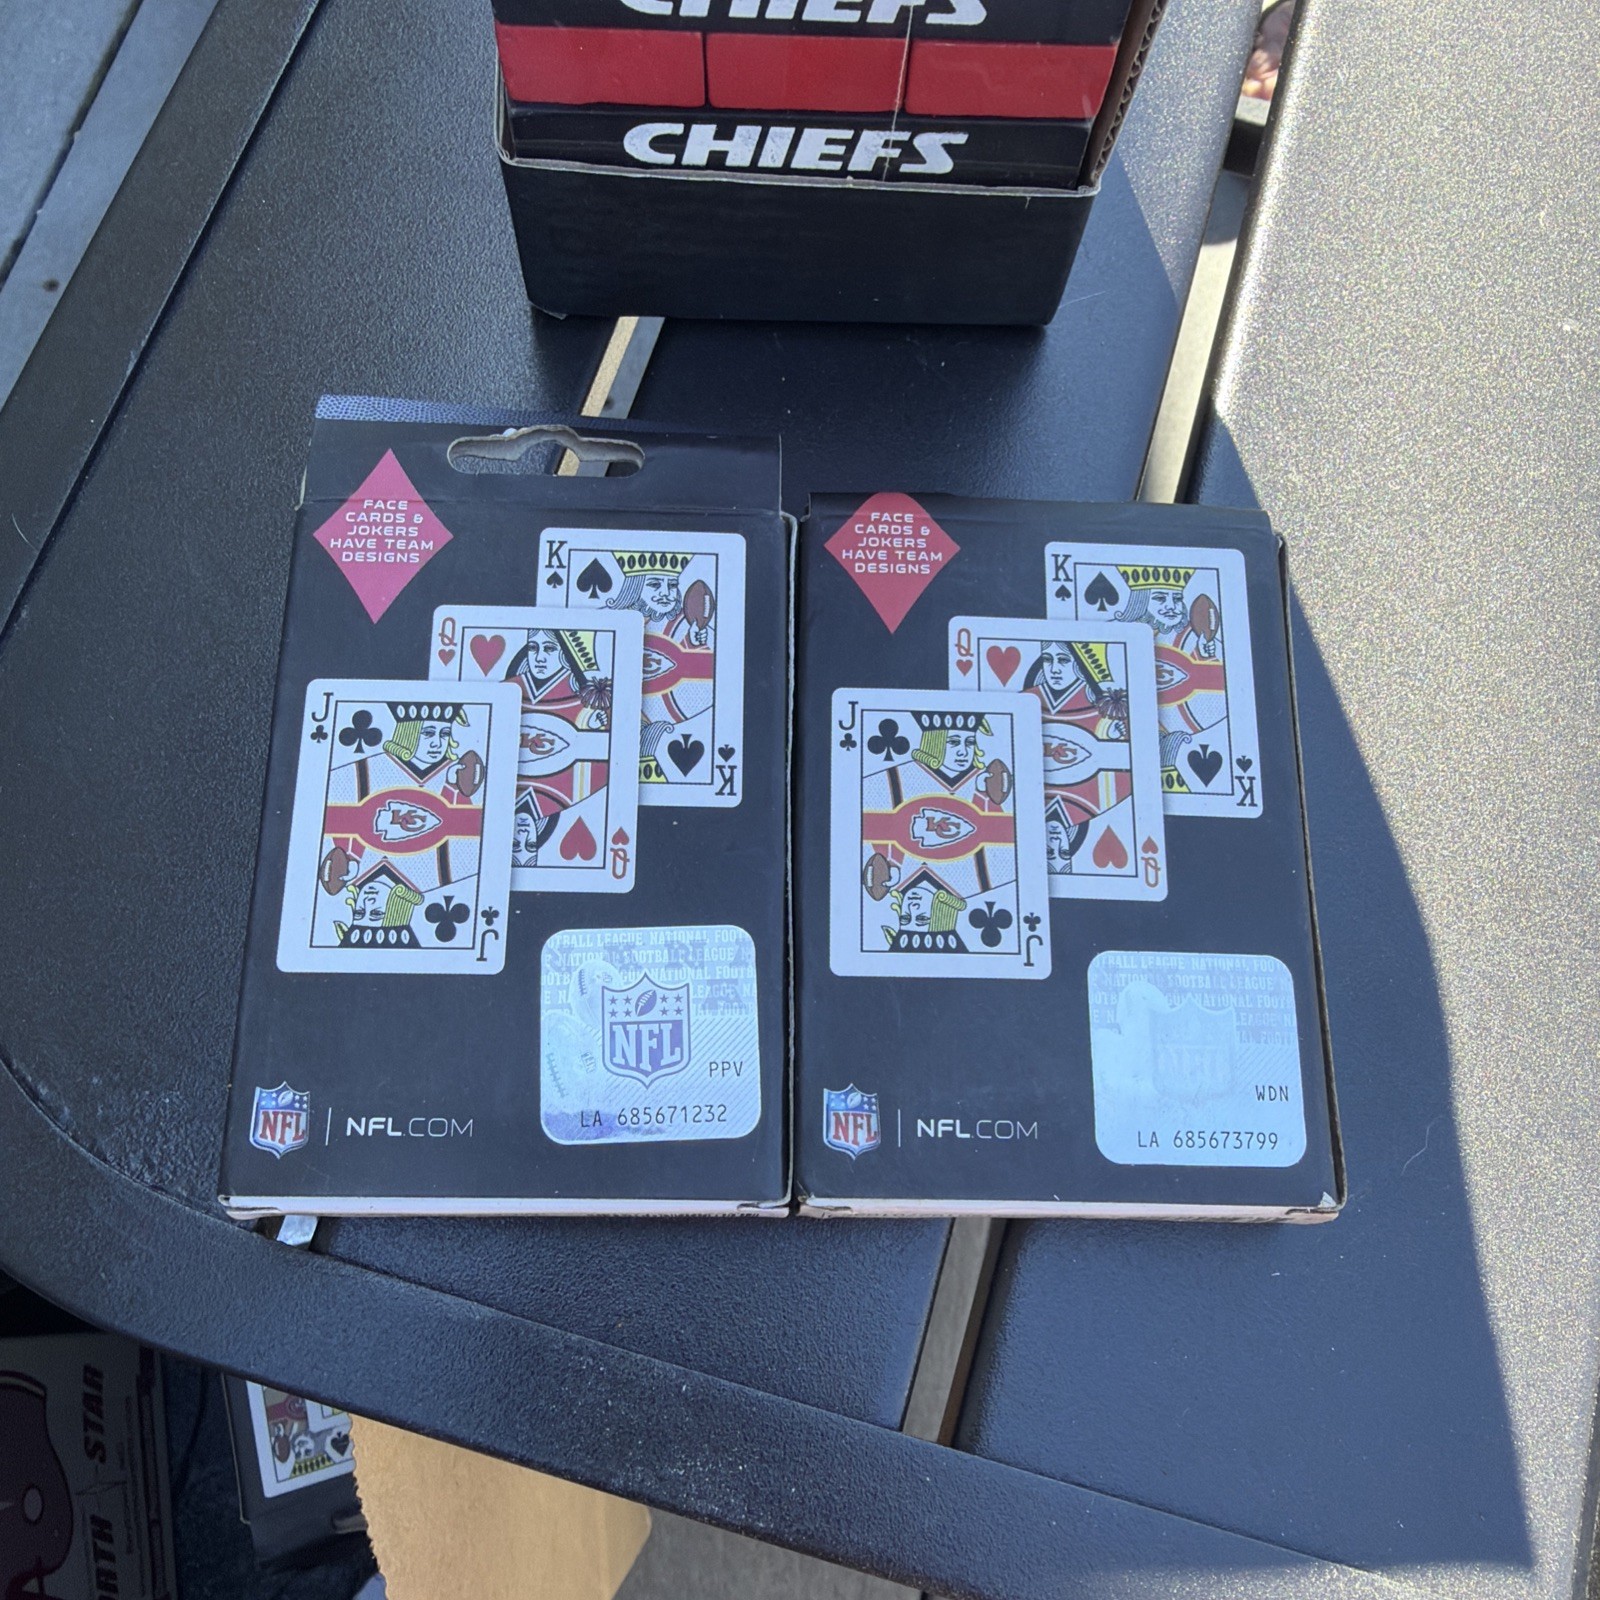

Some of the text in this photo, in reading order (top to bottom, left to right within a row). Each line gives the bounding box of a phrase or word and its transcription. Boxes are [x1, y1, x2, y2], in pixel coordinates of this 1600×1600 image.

[622, 122, 970, 175] CHIEFS
[345, 511, 424, 524] CARDS &
[363, 499, 409, 511] FACE
[870, 512, 914, 523] FACE
[329, 538, 434, 551] HAVE TEAM
[346, 525, 419, 537] JOKERS
[854, 523, 931, 536] CARDS &
[857, 537, 927, 549] JOKERS
[341, 551, 421, 564] DESIGNS
[545, 540, 568, 570] K
[841, 549, 943, 562] HAVE TEAM
[854, 562, 931, 575] DESIGNS
[1051, 553, 1073, 583] K
[438, 616, 458, 647] Q
[954, 627, 974, 658] Q
[311, 691, 334, 722] J
[838, 700, 860, 731] J
[715, 764, 738, 797] K
[1235, 775, 1258, 807] K
[610, 847, 629, 880] Q
[1142, 856, 1162, 888] Q
[476, 929, 499, 962] J
[649, 928, 710, 945] NATIONAL
[1023, 934, 1044, 967] J
[612, 1022, 682, 1073] NFL
[708, 1061, 744, 1078] PPV
[1255, 1084, 1290, 1102] WDN
[259, 1110, 306, 1146] NFL
[346, 1117, 474, 1138] NFL.COM
[579, 1104, 728, 1128] LA 685671232
[831, 1111, 878, 1147] NFL
[916, 1118, 1039, 1140] NFL.COM
[1136, 1130, 1279, 1150] LA 685673799
[82, 1363, 108, 1465] STAR
[89, 1514, 120, 1600] RTH
